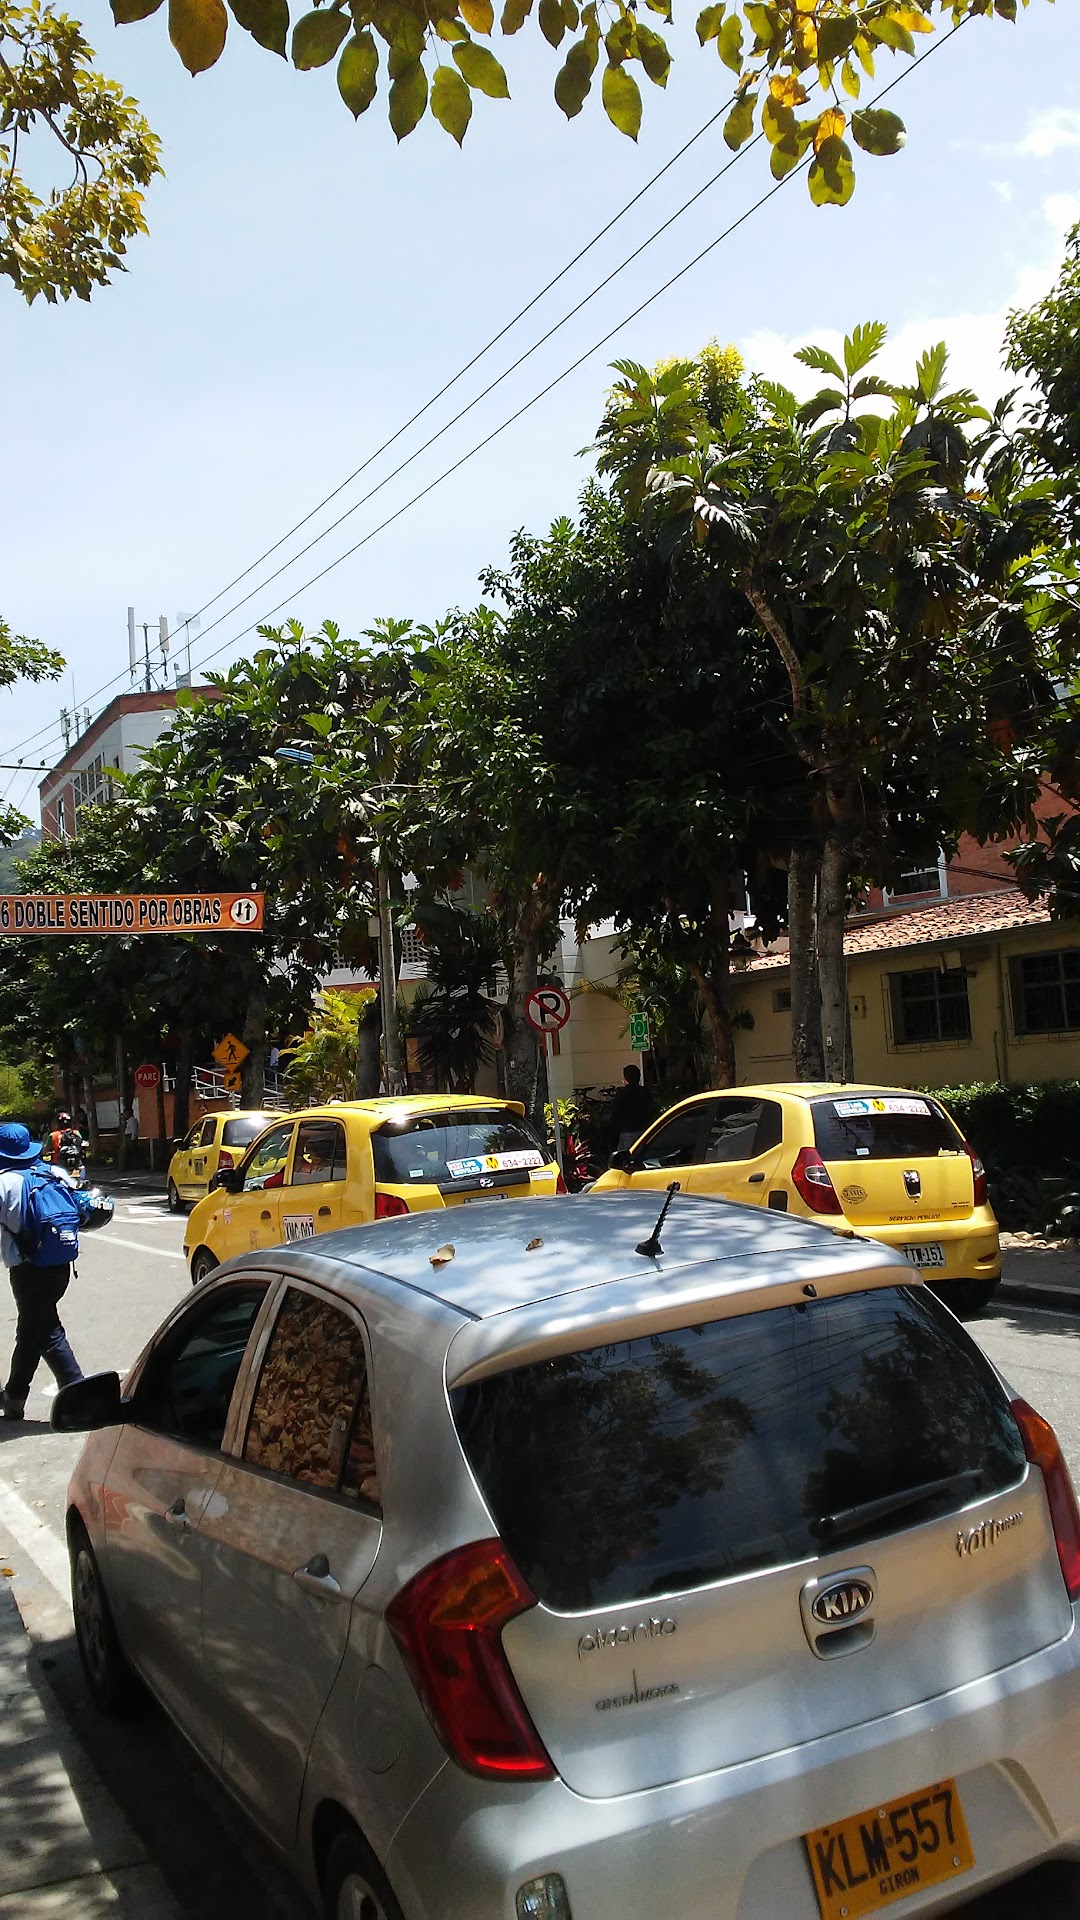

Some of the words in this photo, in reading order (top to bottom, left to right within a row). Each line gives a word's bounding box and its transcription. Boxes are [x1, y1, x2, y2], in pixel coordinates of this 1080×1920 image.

[0, 900, 10, 928] 6
[14, 900, 66, 928] DOBLE
[69, 898, 134, 928] SENTIDO
[138, 898, 169, 927] POR
[173, 898, 221, 925] OBRAS
[138, 1073, 157, 1081] PARE
[453, 1166, 481, 1176] MOVILES
[502, 1157, 543, 1168] 634-2222
[822, 1587, 866, 1619] KIA
[879, 1866, 921, 1896] GIRON
